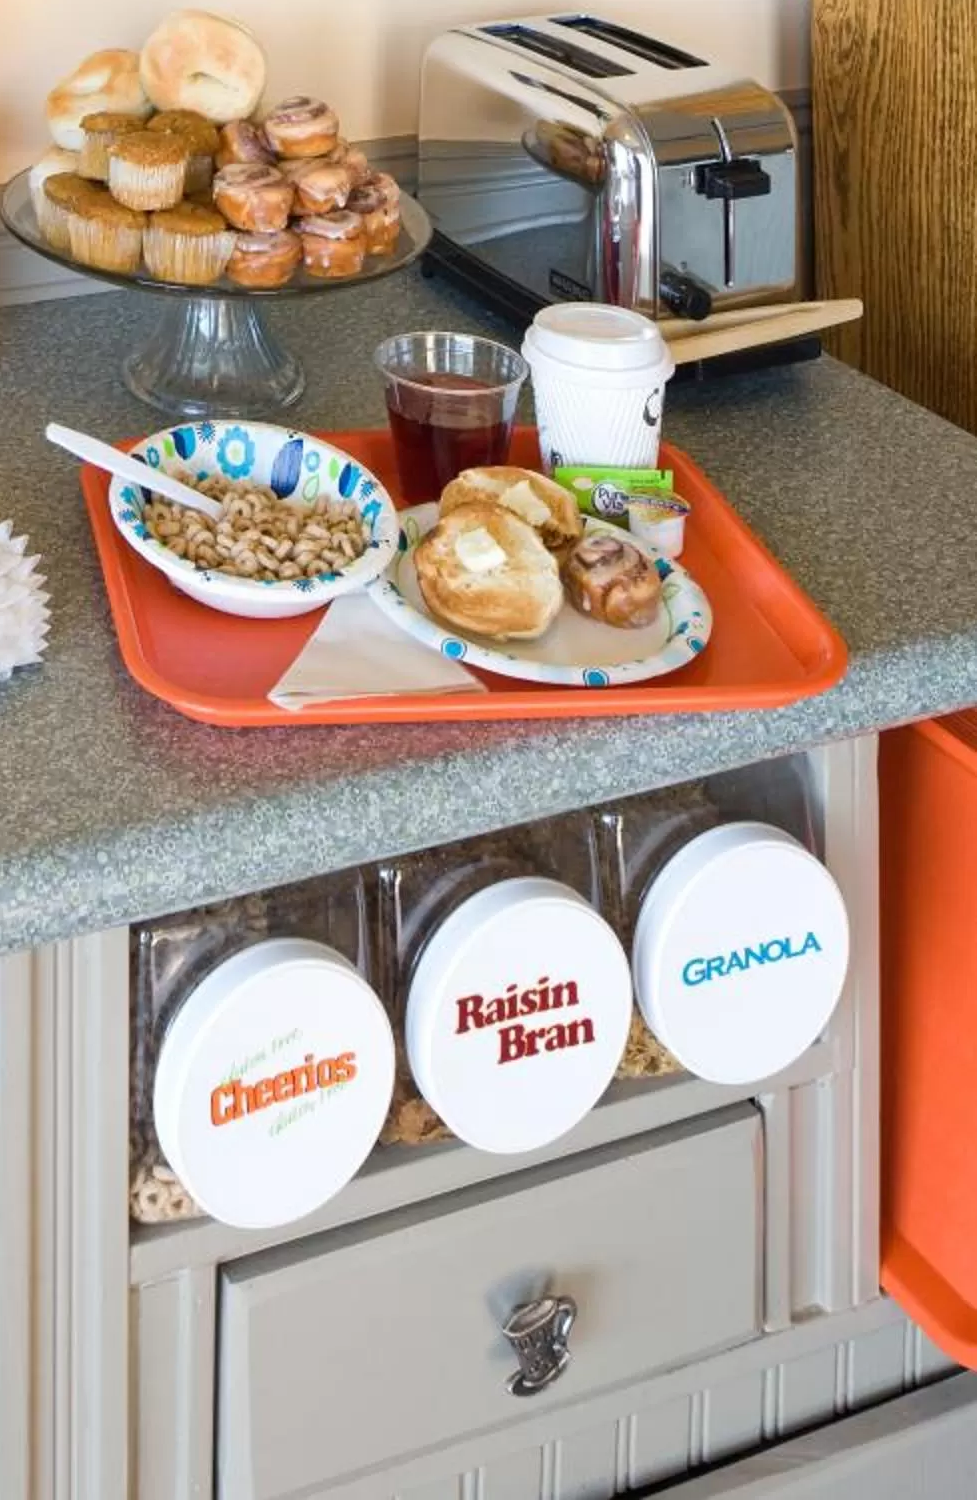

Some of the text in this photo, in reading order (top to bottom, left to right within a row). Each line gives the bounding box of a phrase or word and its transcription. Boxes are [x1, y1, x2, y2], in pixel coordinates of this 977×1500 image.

[682, 932, 822, 986] GRANOLA
[455, 977, 579, 1035] Raisin
[497, 1018, 596, 1065] Bran
[210, 1051, 358, 1127] Cheerios
